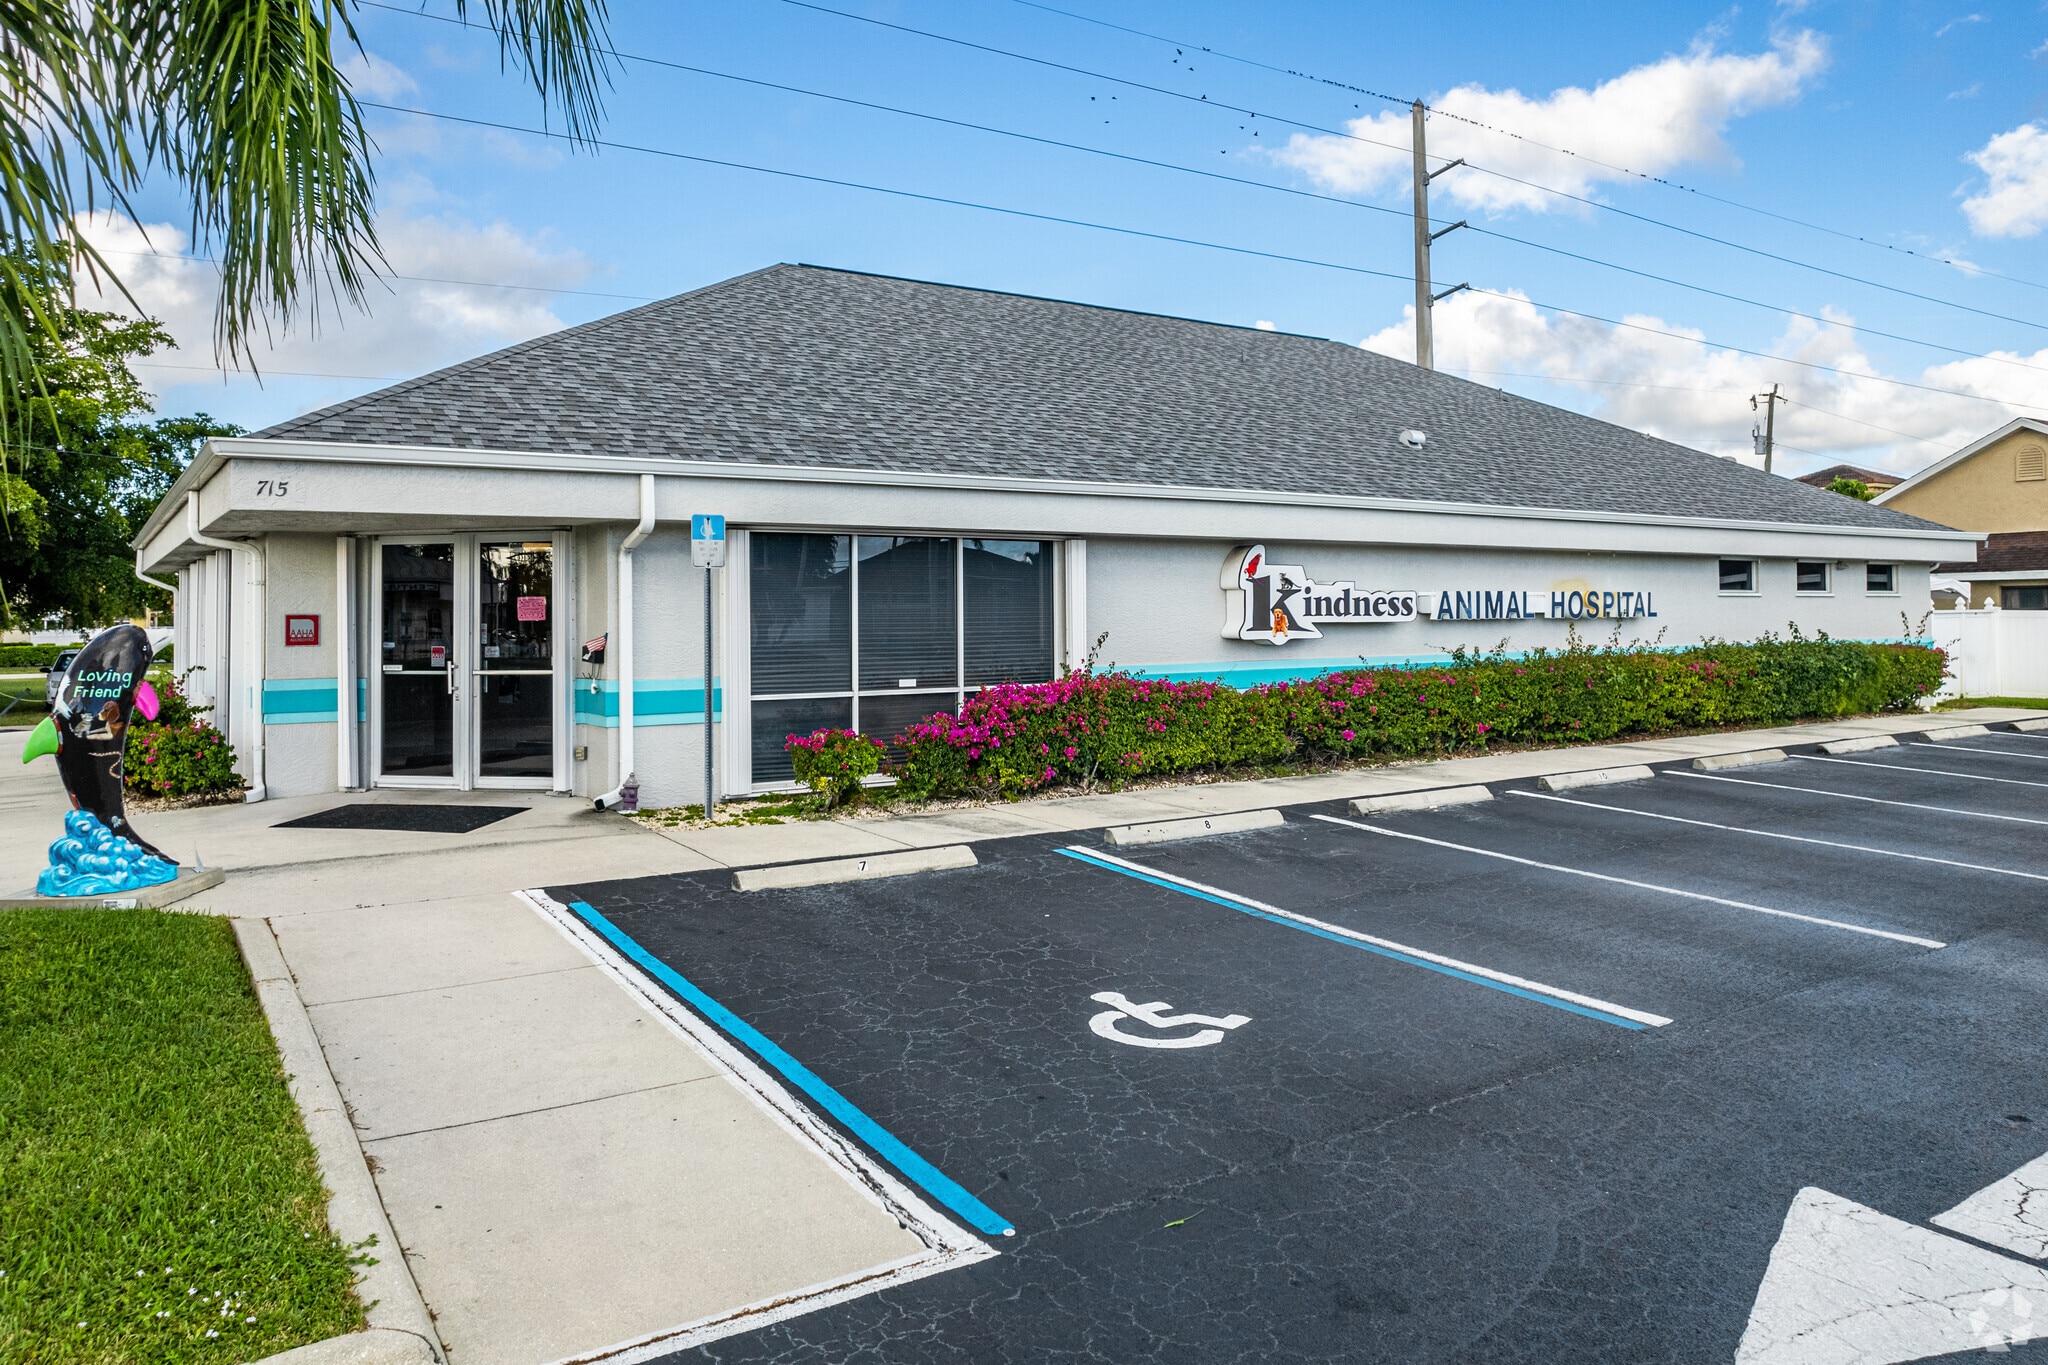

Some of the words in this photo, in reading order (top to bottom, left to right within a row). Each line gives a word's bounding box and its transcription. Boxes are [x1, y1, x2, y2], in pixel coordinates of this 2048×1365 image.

[257, 480, 289, 497] 715
[1437, 590, 1536, 620] ANIMAL
[1551, 590, 1658, 619] HOSPITAL
[291, 629, 314, 638] AAHA
[77, 669, 133, 688] Loving
[73, 685, 122, 698] Friend
[1204, 820, 1212, 829] 8
[859, 860, 867, 871] 7
